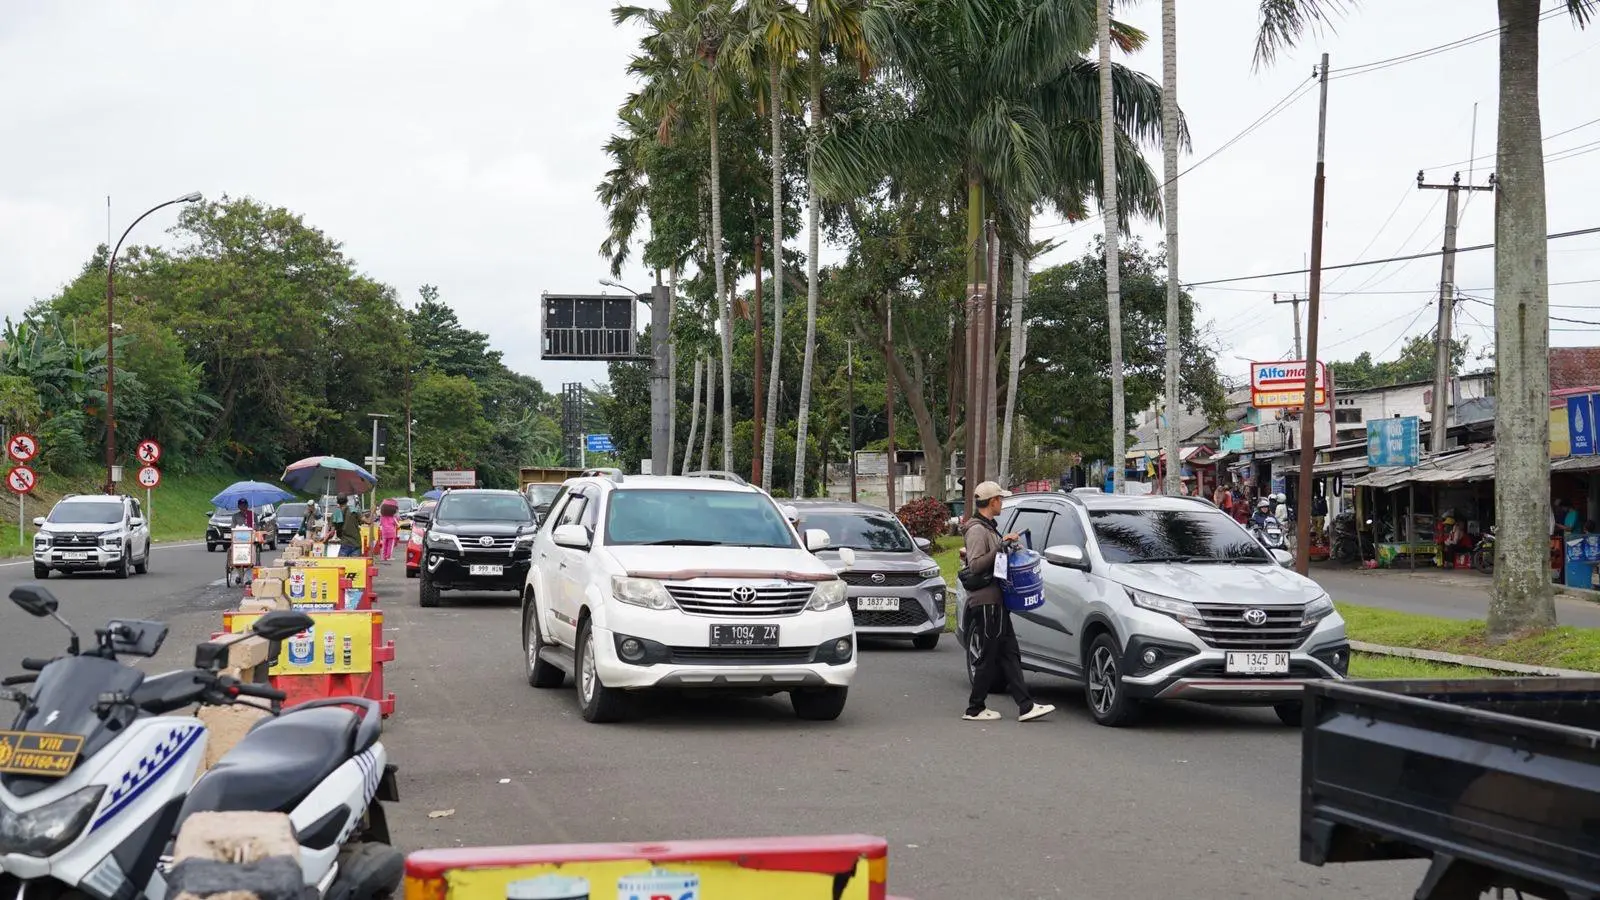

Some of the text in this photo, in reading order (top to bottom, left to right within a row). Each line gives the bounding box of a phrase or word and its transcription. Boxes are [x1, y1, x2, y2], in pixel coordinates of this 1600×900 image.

[1259, 367, 1318, 379] Alfama
[858, 598, 864, 606] B
[866, 598, 884, 606] 1837
[1024, 594, 1039, 606] IBU
[713, 626, 777, 639] E 1094 ZX
[1229, 653, 1287, 666] A 1345 DK
[39, 736, 63, 751] VIII
